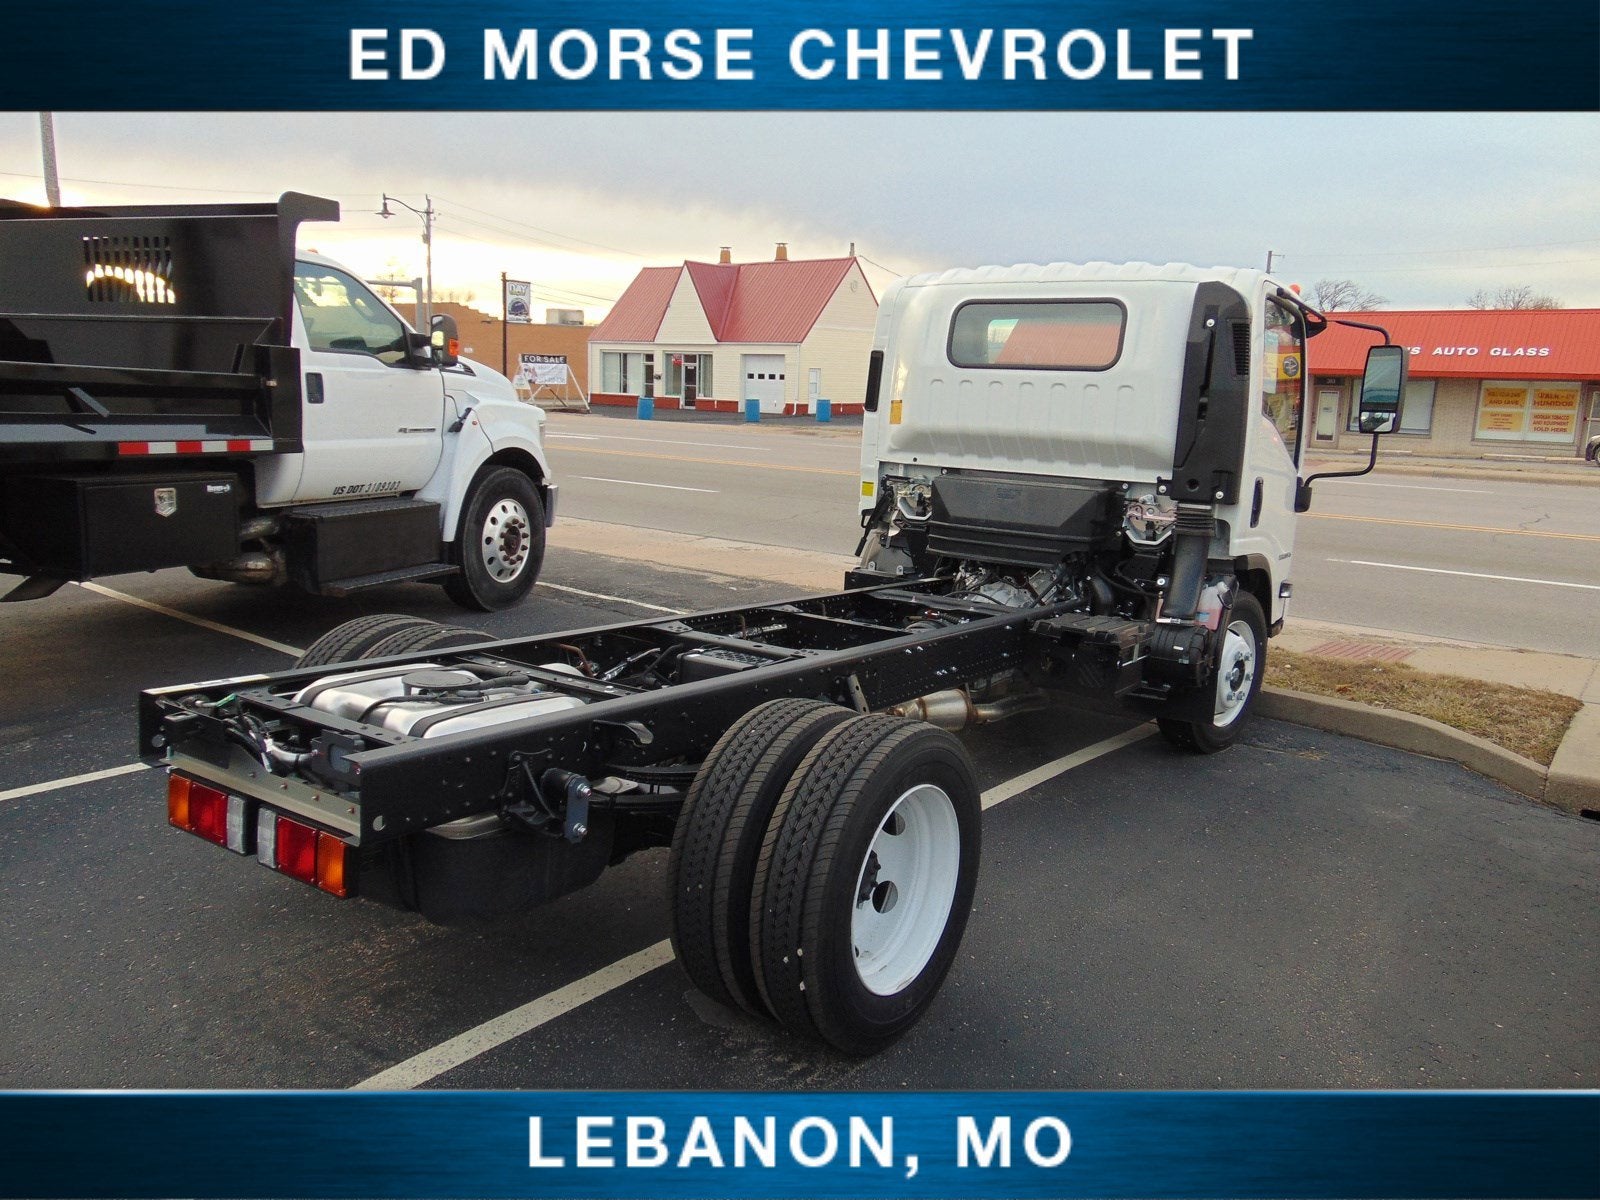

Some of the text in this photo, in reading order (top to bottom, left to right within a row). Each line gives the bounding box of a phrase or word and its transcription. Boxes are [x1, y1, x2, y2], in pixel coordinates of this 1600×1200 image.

[1432, 347, 1479, 356] AUTO
[1490, 347, 1550, 356] GLASS
[524, 355, 565, 364] FOR SALE
[333, 486, 346, 496] US
[346, 484, 365, 494] DOT
